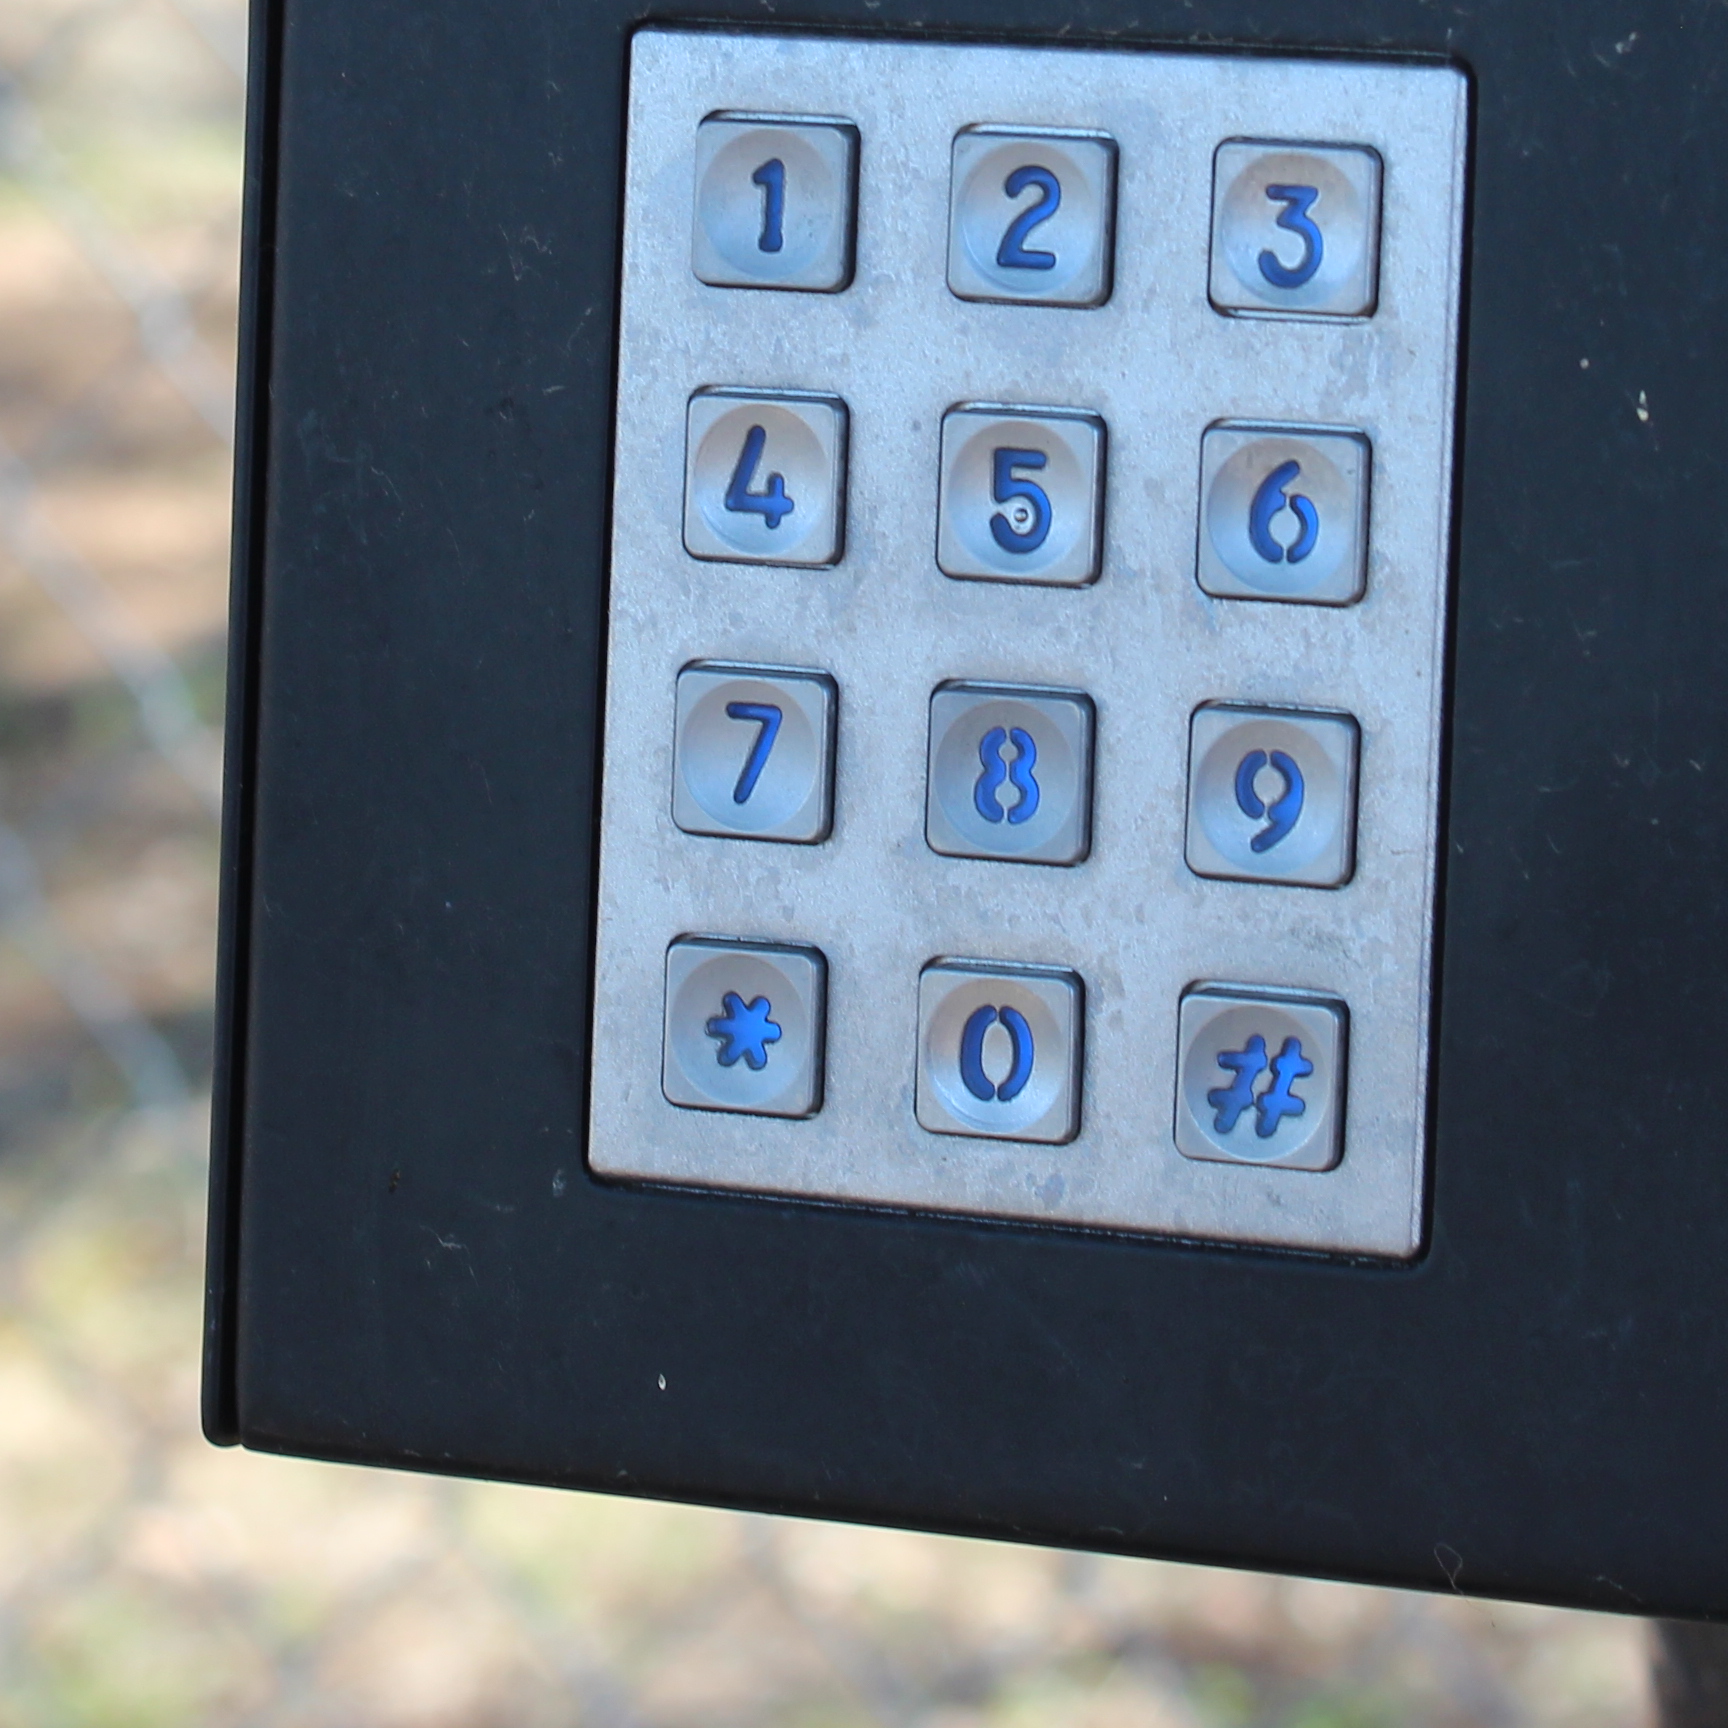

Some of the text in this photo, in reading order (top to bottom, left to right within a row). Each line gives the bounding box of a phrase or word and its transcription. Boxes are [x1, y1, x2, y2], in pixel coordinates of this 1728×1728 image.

[751, 156, 1325, 290] 1 2 3
[724, 424, 1320, 566] 4 5 6
[724, 701, 1306, 855] 7 8 9
[959, 1003, 1037, 1104] 0
